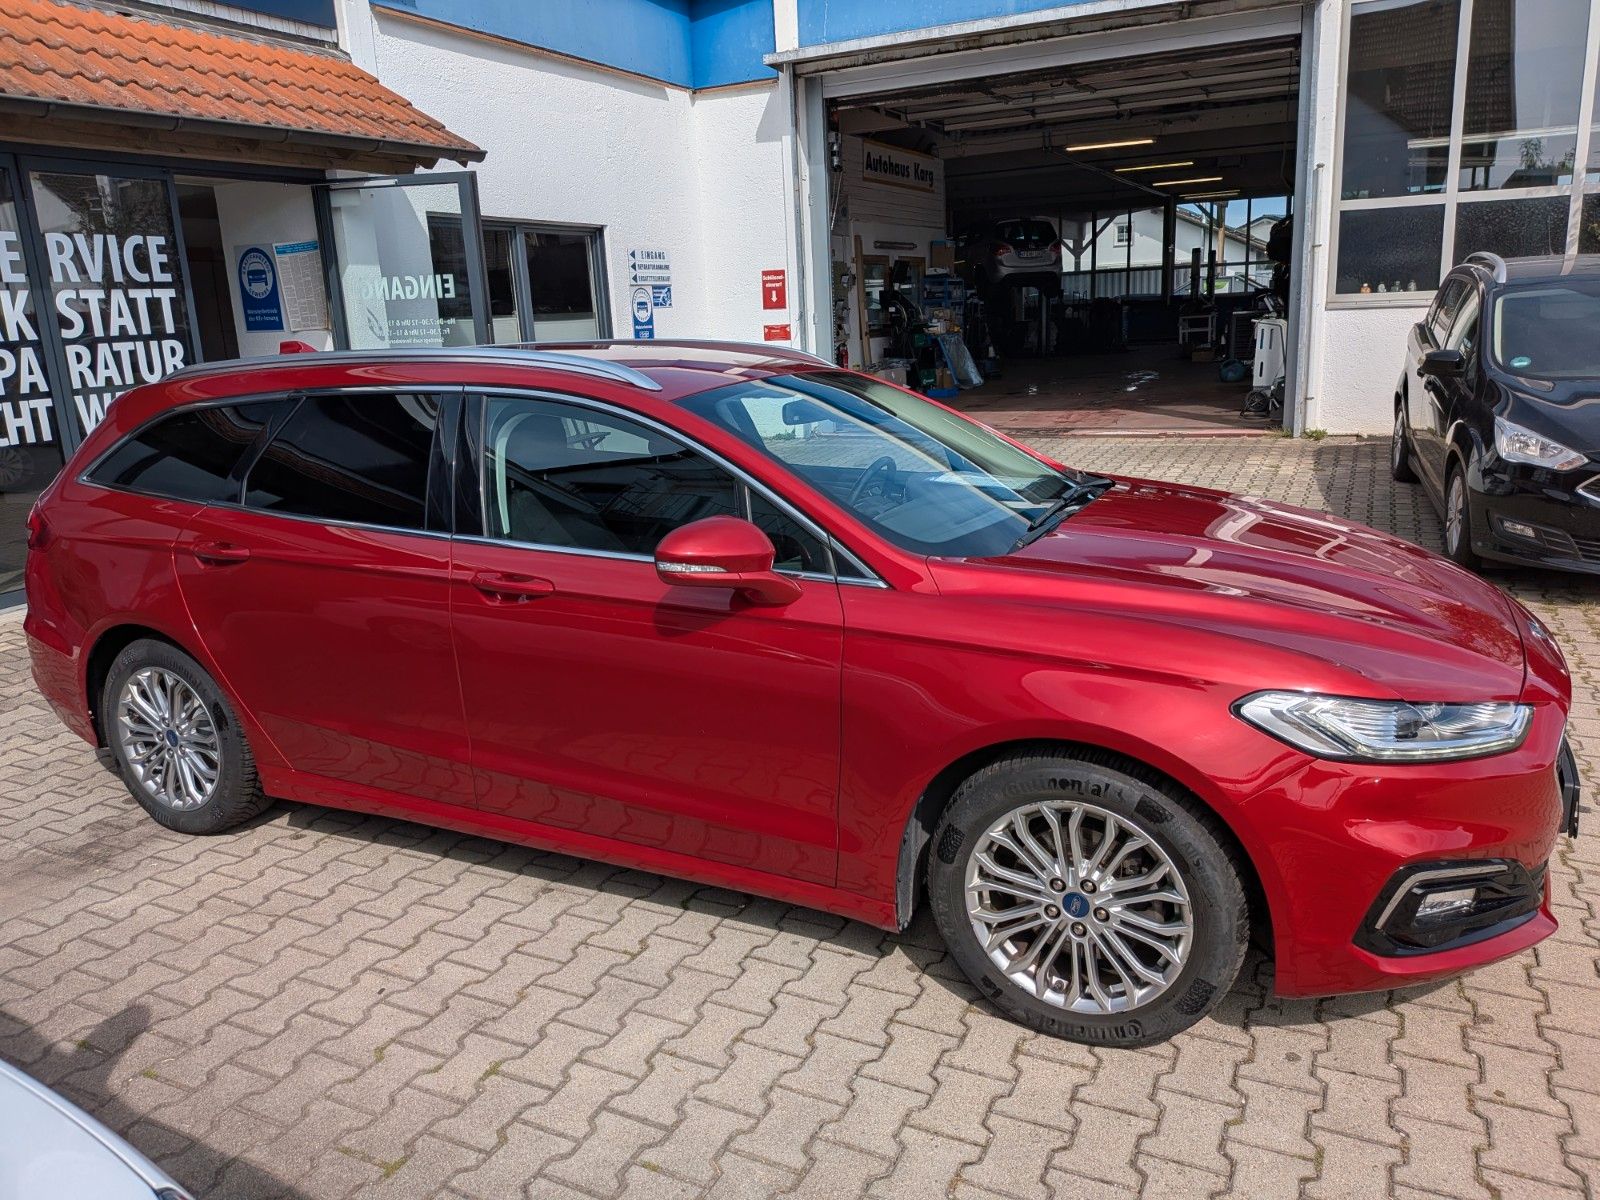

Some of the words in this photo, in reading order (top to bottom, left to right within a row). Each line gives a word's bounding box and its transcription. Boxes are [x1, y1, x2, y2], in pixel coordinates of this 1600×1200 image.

[866, 151, 911, 178] Autohaus
[913, 162, 934, 188] Karg
[45, 232, 173, 283] RVICE
[55, 288, 176, 341] STATT
[65, 339, 185, 390] RATUR
[0, 398, 53, 446] HT
